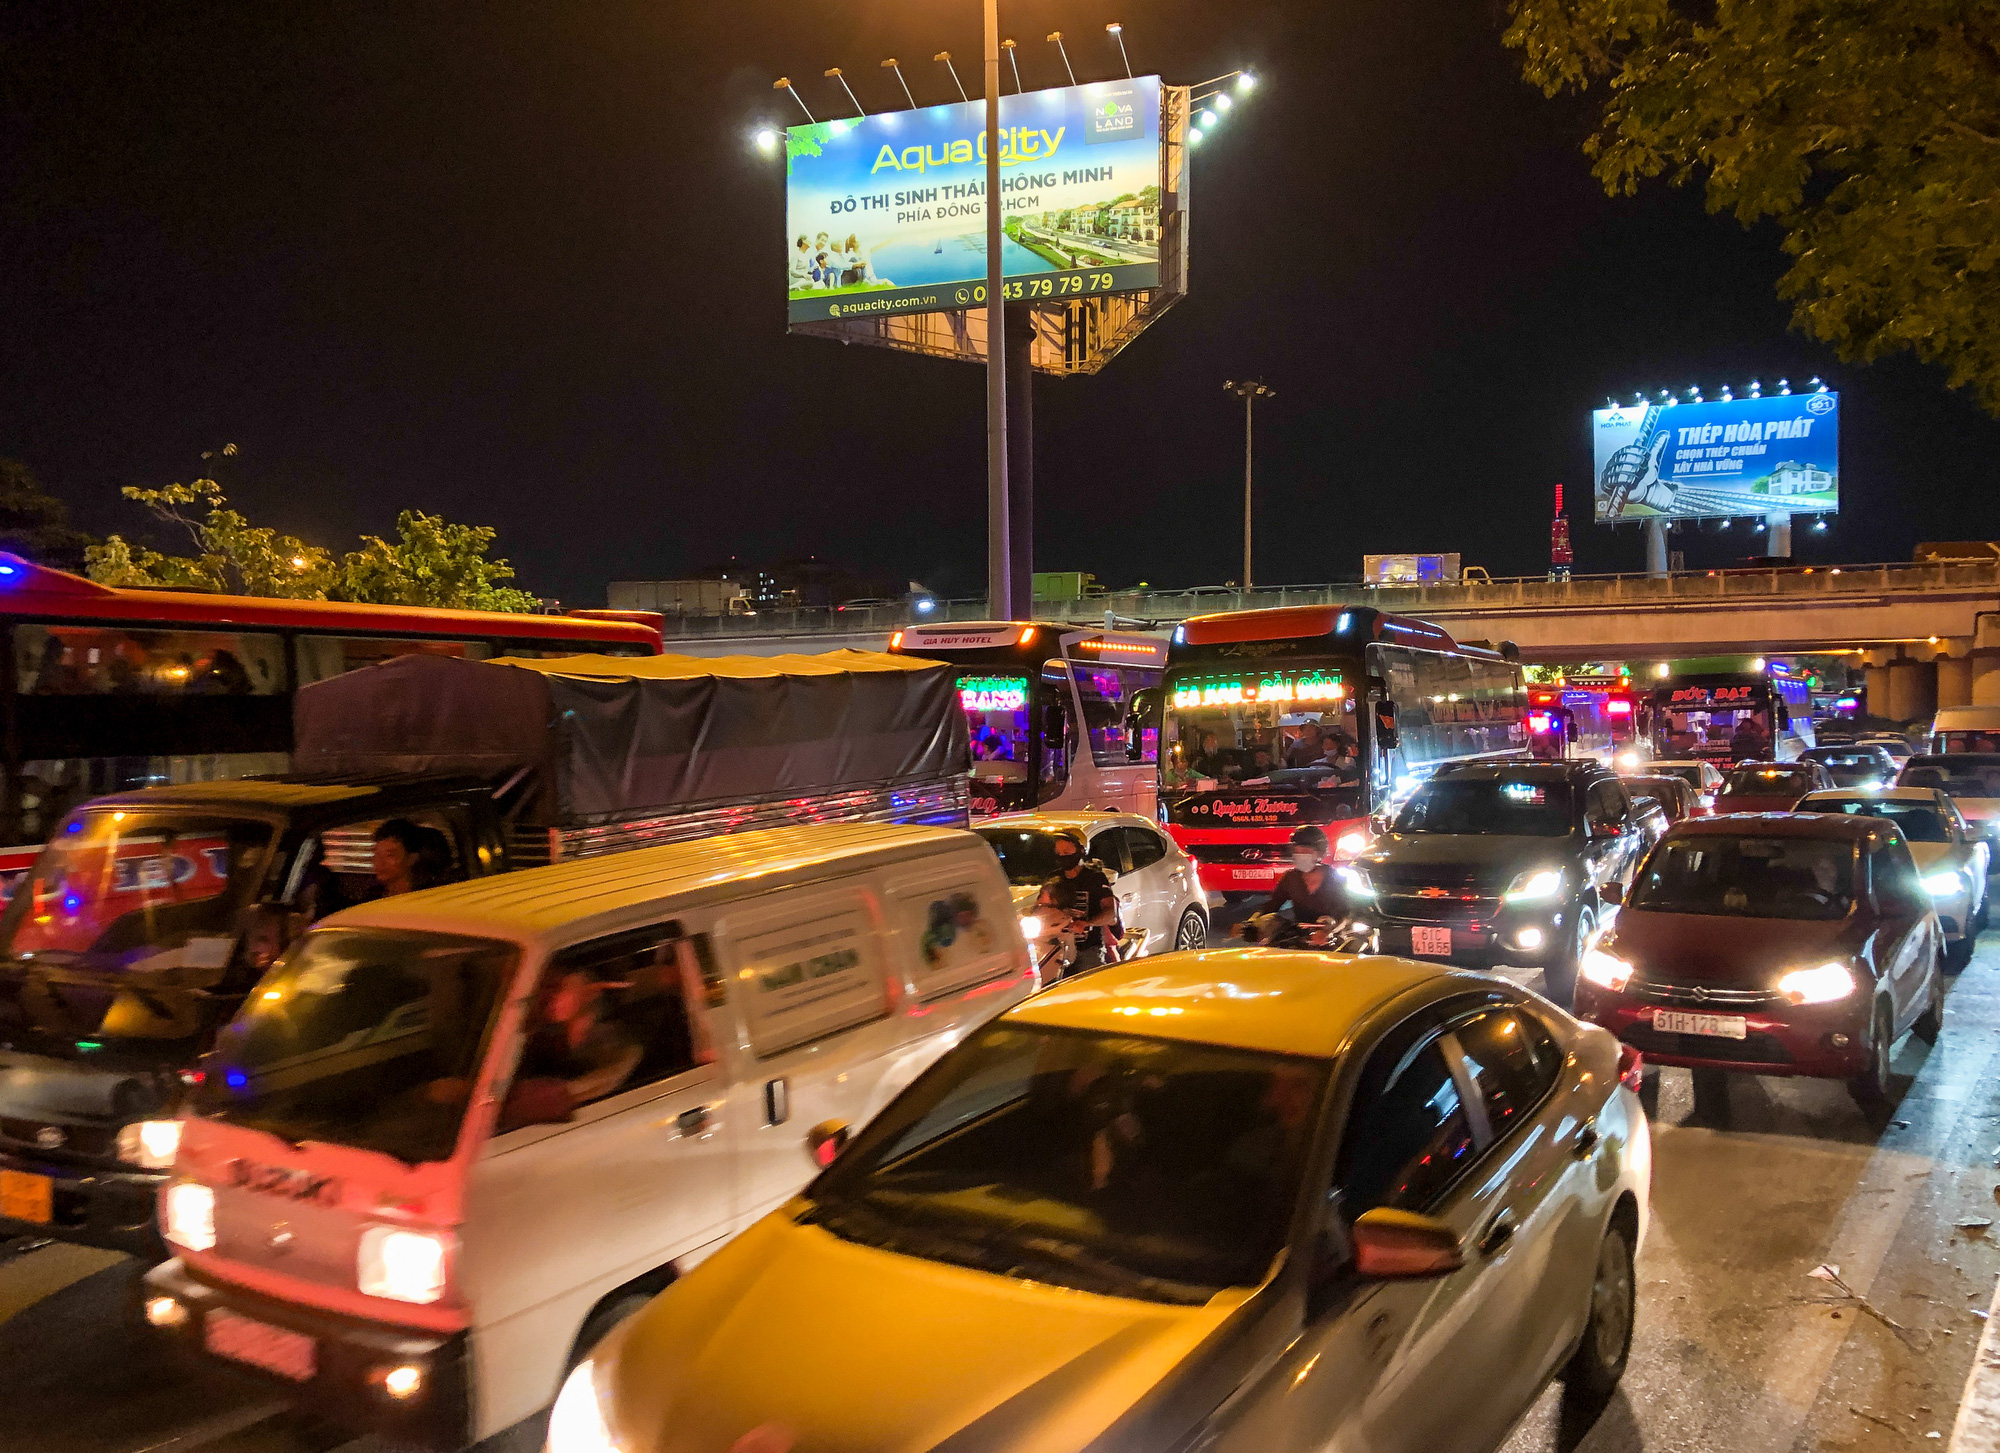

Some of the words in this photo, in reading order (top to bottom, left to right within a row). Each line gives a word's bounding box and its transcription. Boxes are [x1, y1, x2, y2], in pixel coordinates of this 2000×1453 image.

[1096, 117, 1133, 128] LAND
[871, 139, 973, 174] Aqua
[977, 126, 1066, 158] City
[861, 194, 889, 212] THỊ
[894, 187, 938, 206] SINH
[942, 179, 986, 200] THÁI
[1002, 173, 1057, 193] HÔNG
[1063, 166, 1113, 185] MINH
[897, 208, 932, 224] PHÍA
[936, 202, 981, 219] ĐÔNG
[842, 294, 937, 315] aquacity.com.vn
[973, 281, 1023, 302] 043
[1029, 279, 1053, 297] 79
[1059, 275, 1083, 293] 79
[1089, 272, 1114, 290] 79
[1678, 422, 1723, 446] THÉP
[1723, 420, 1762, 443] HÒA
[1764, 416, 1815, 440] PHÁT
[1675, 448, 1703, 461] CHỌN
[1705, 445, 1730, 458] THÉP
[1673, 460, 1692, 473] XÂY
[1693, 459, 1713, 472] NHÀ
[961, 636, 993, 644] HOTEL
[1671, 685, 1707, 701] ĐỨC
[1714, 686, 1751, 701] ĐẠT
[1421, 929, 1442, 941] 61C
